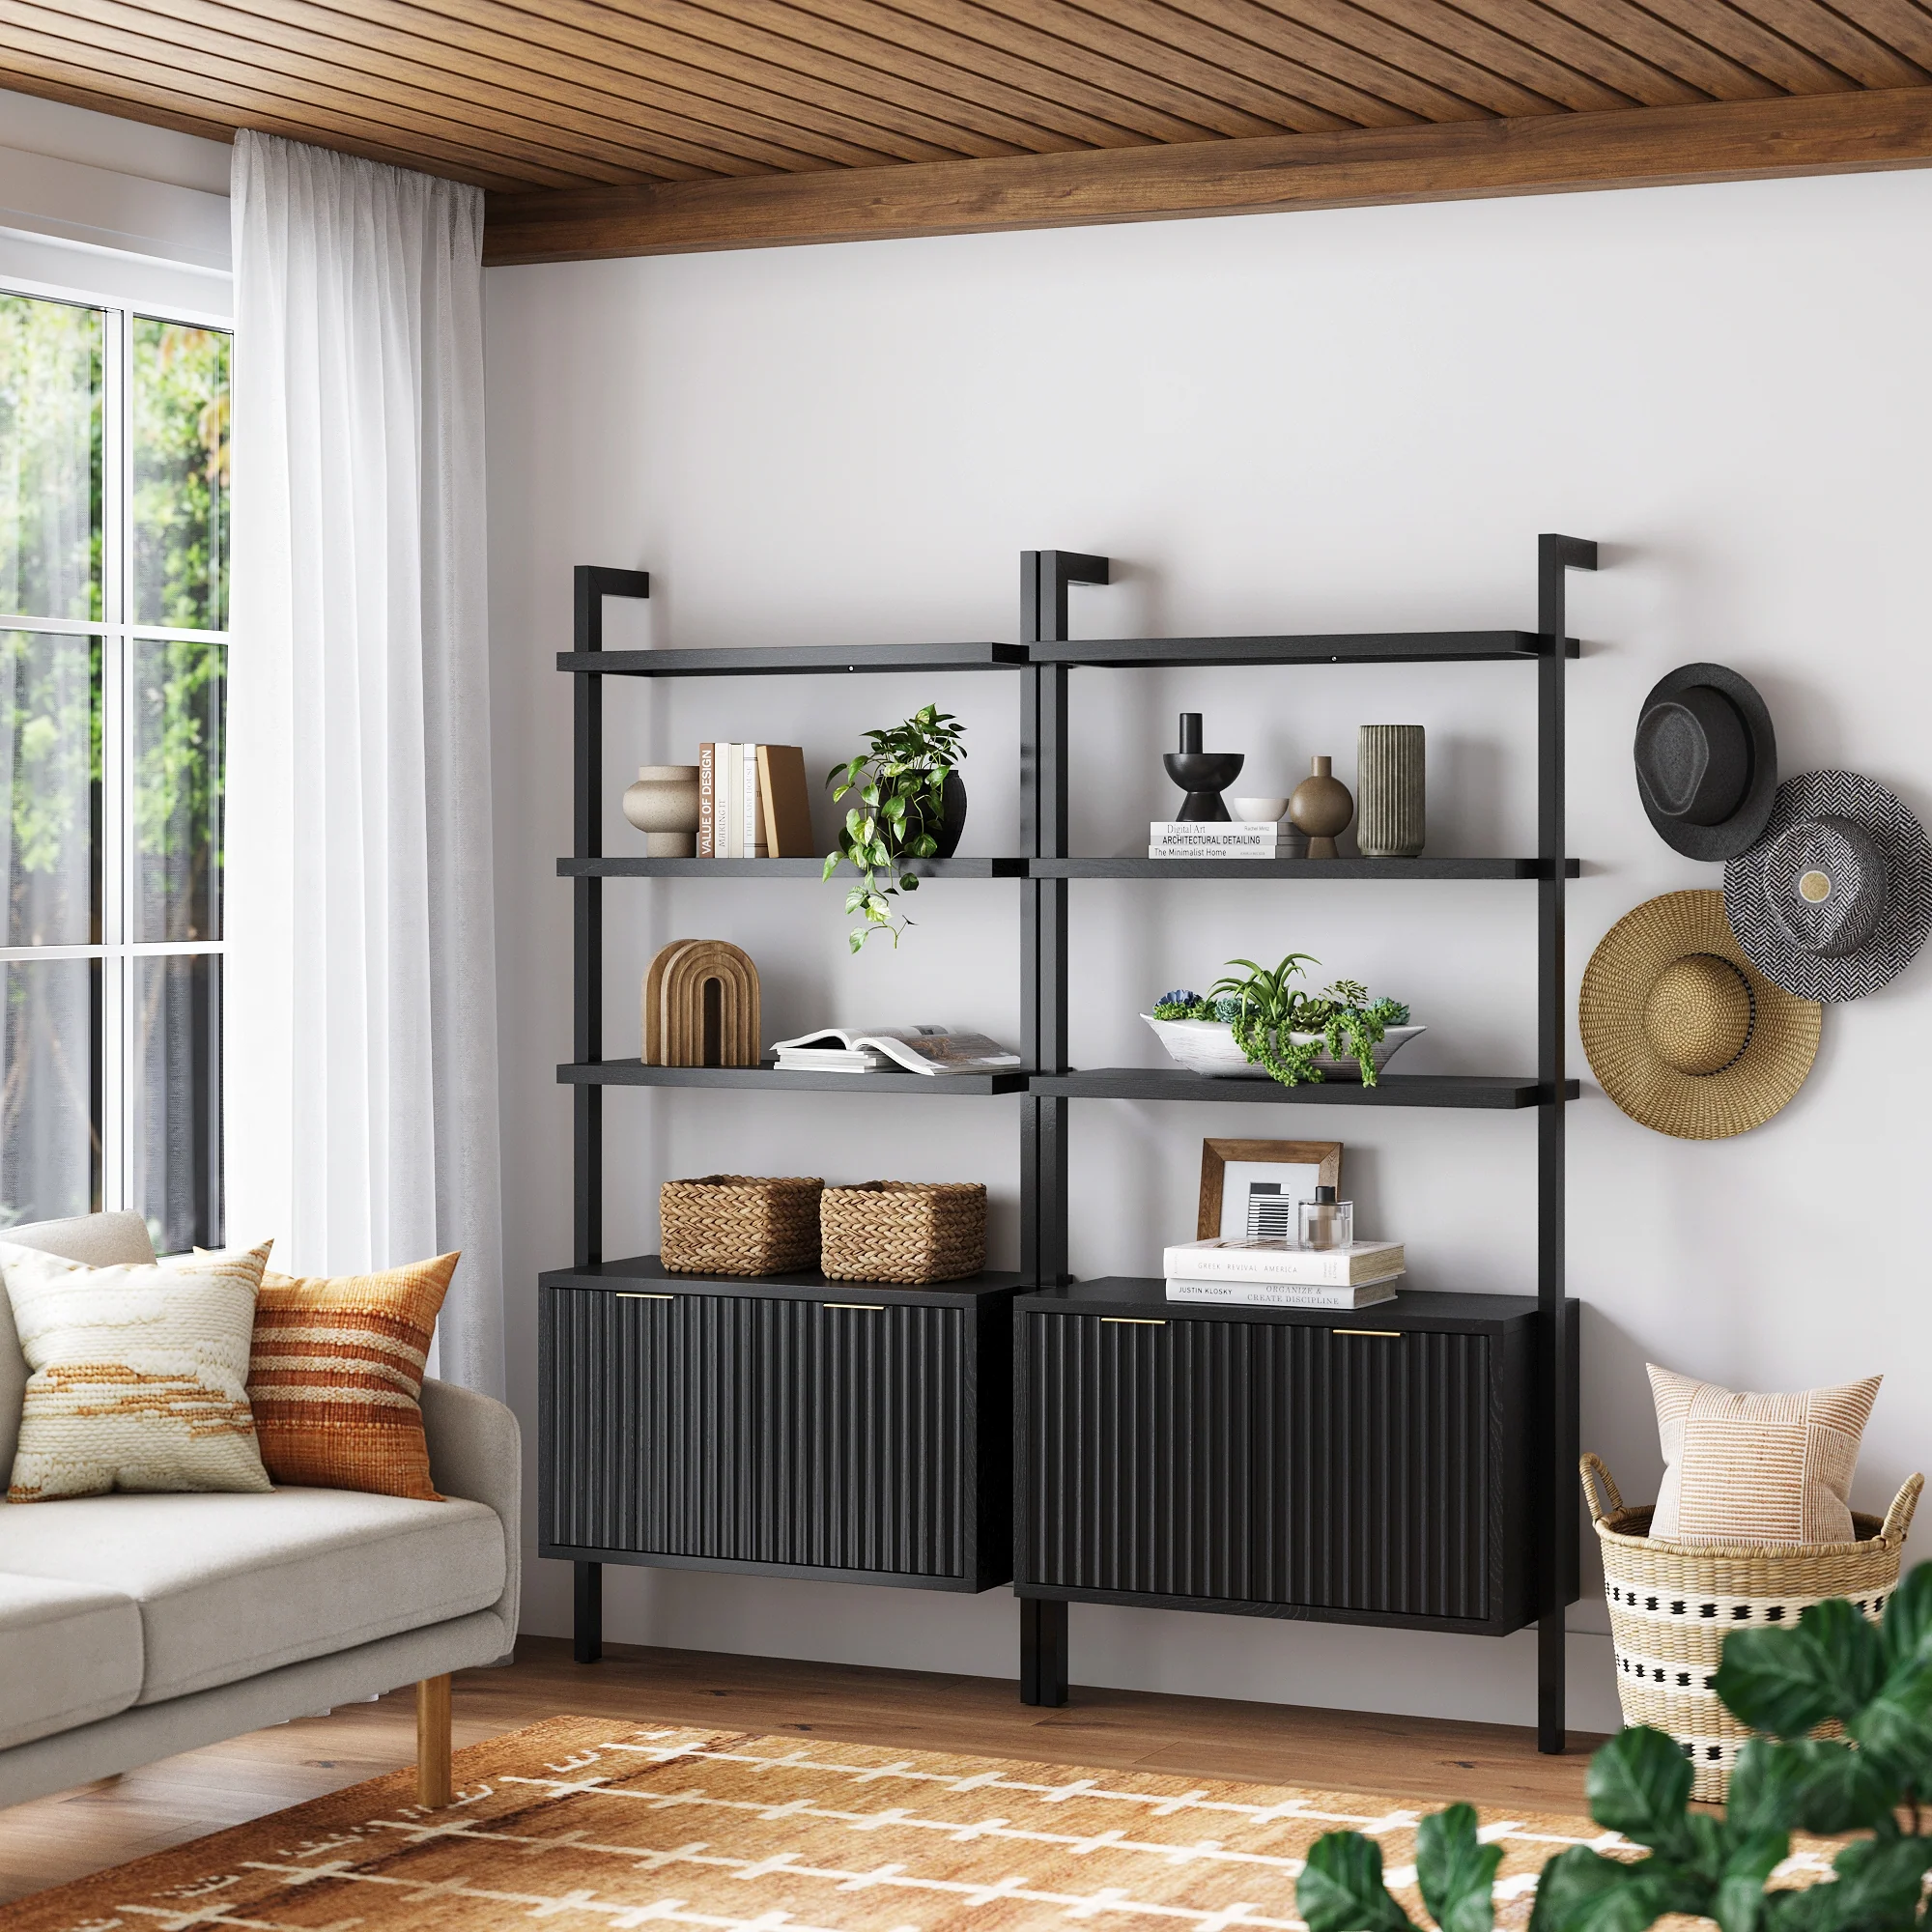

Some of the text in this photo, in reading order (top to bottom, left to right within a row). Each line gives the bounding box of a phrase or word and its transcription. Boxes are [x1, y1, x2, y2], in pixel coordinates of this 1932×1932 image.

[701, 750, 712, 855] VALUE OF DESIGN
[718, 799, 725, 808] IT
[1167, 824, 1206, 837] Digital Art
[1162, 836, 1261, 844] ARCHITECTURAL DETAILING
[1154, 847, 1166, 856] The
[1168, 847, 1205, 856] Minimalist
[1265, 1285, 1313, 1294] ORGANIZE
[1247, 1293, 1339, 1305] CREATE DISCIPLINE
